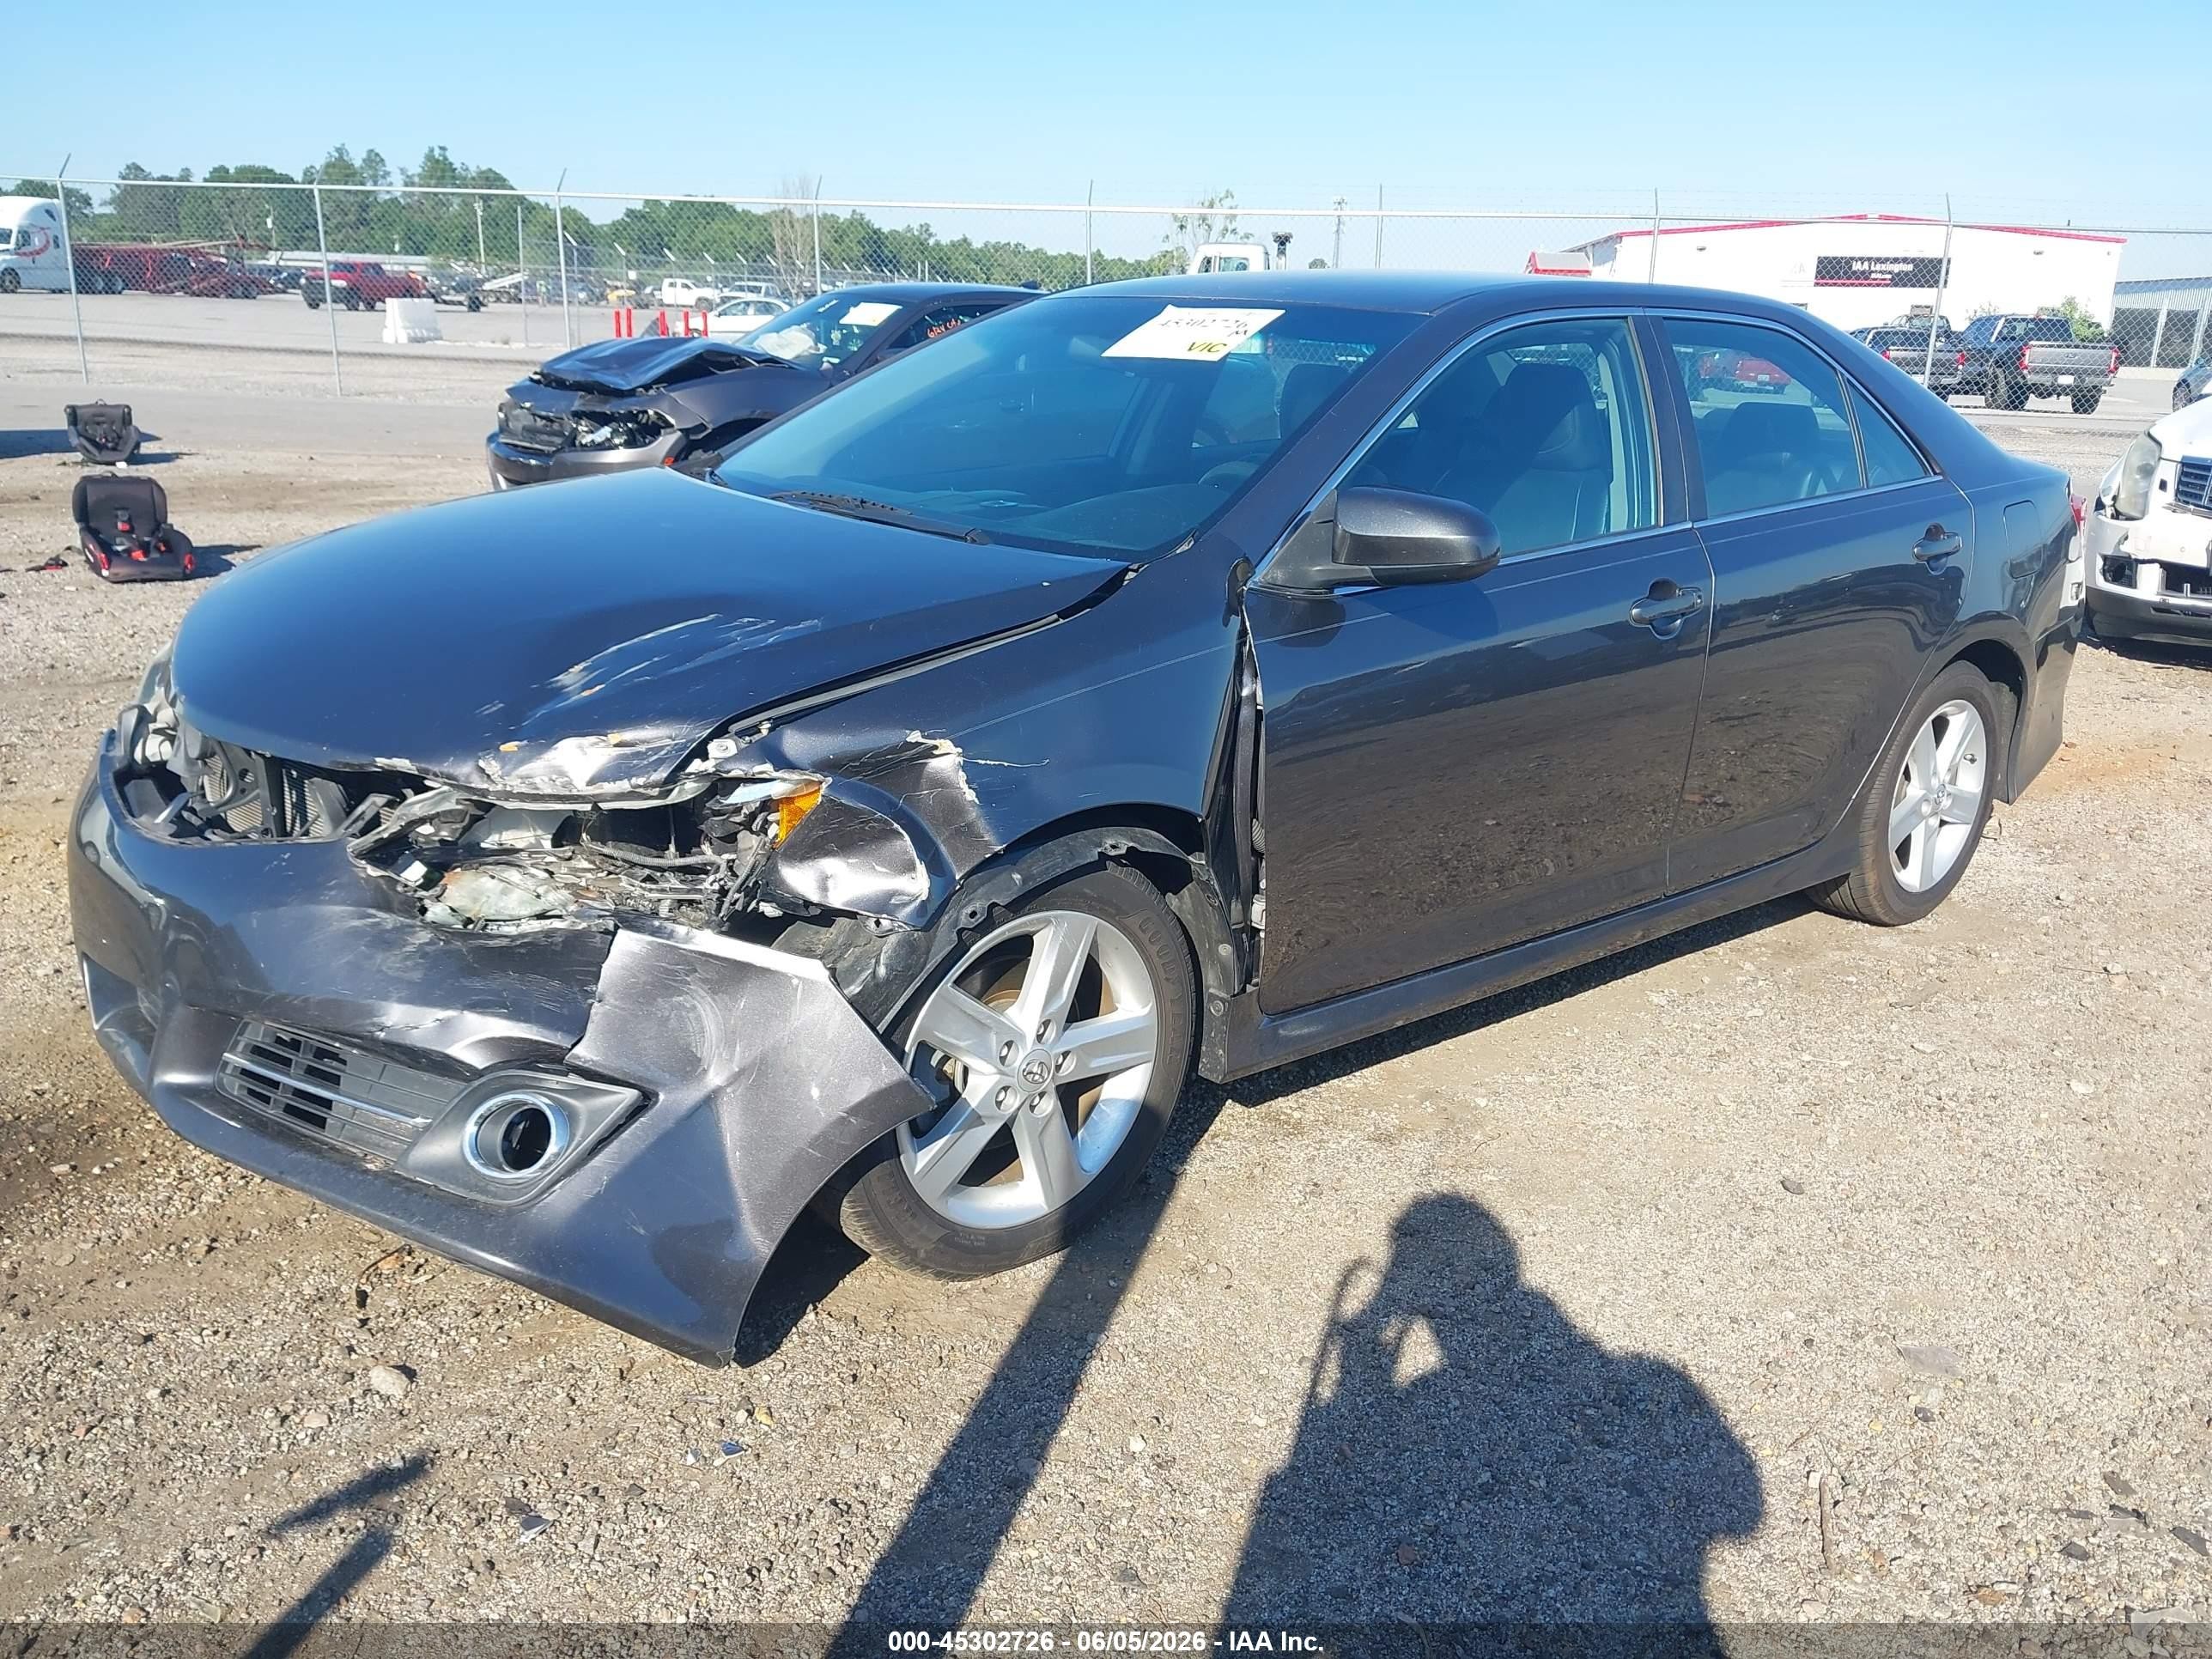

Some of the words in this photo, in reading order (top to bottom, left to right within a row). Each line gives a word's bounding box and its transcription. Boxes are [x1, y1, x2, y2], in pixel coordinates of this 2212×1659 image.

[1852, 260, 1869, 270] IAA
[1871, 261, 1913, 272] Lexington
[1187, 341, 1228, 353] VIC
[1138, 916, 1183, 1065] GOODYEAR
